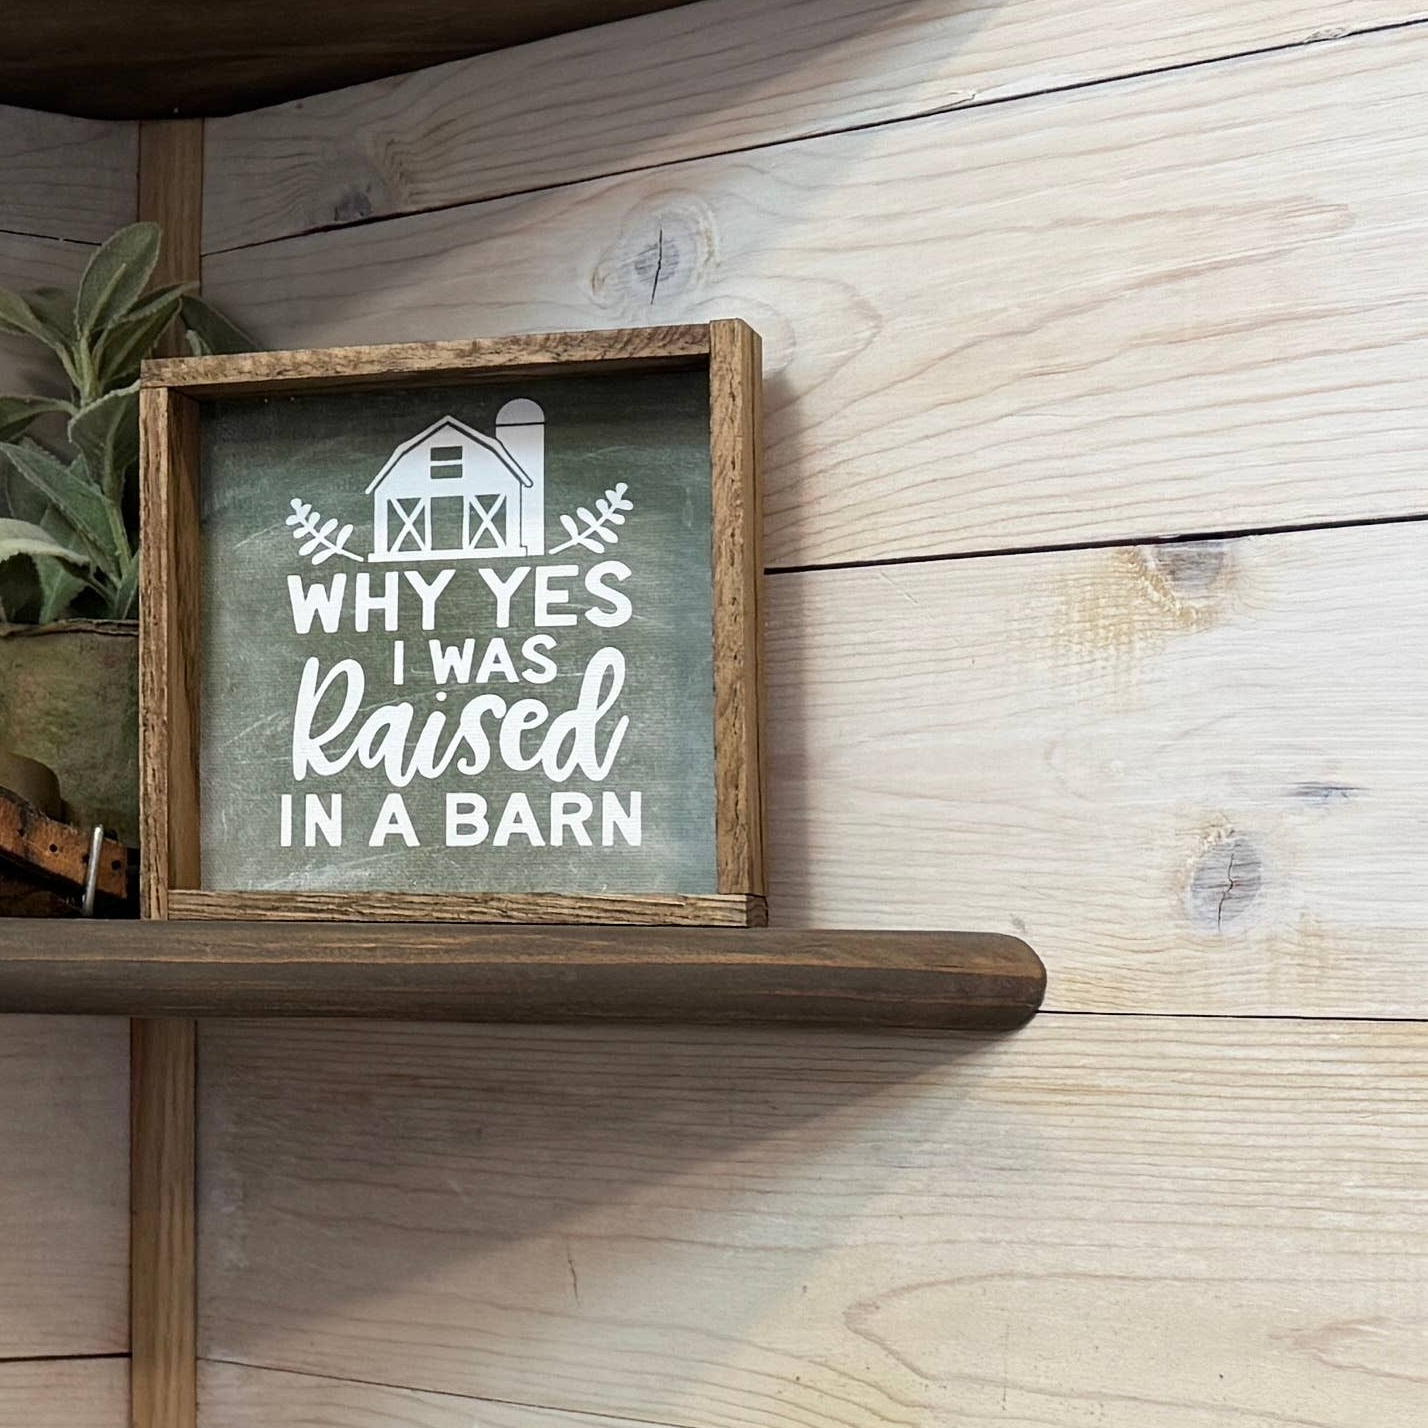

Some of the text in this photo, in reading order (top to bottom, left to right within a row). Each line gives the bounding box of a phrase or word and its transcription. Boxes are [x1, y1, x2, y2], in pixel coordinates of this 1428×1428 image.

[286, 559, 634, 636] WHY YES
[392, 633, 559, 686] I WAS
[291, 645, 631, 789] Raised
[279, 789, 644, 848] IN A BARN
